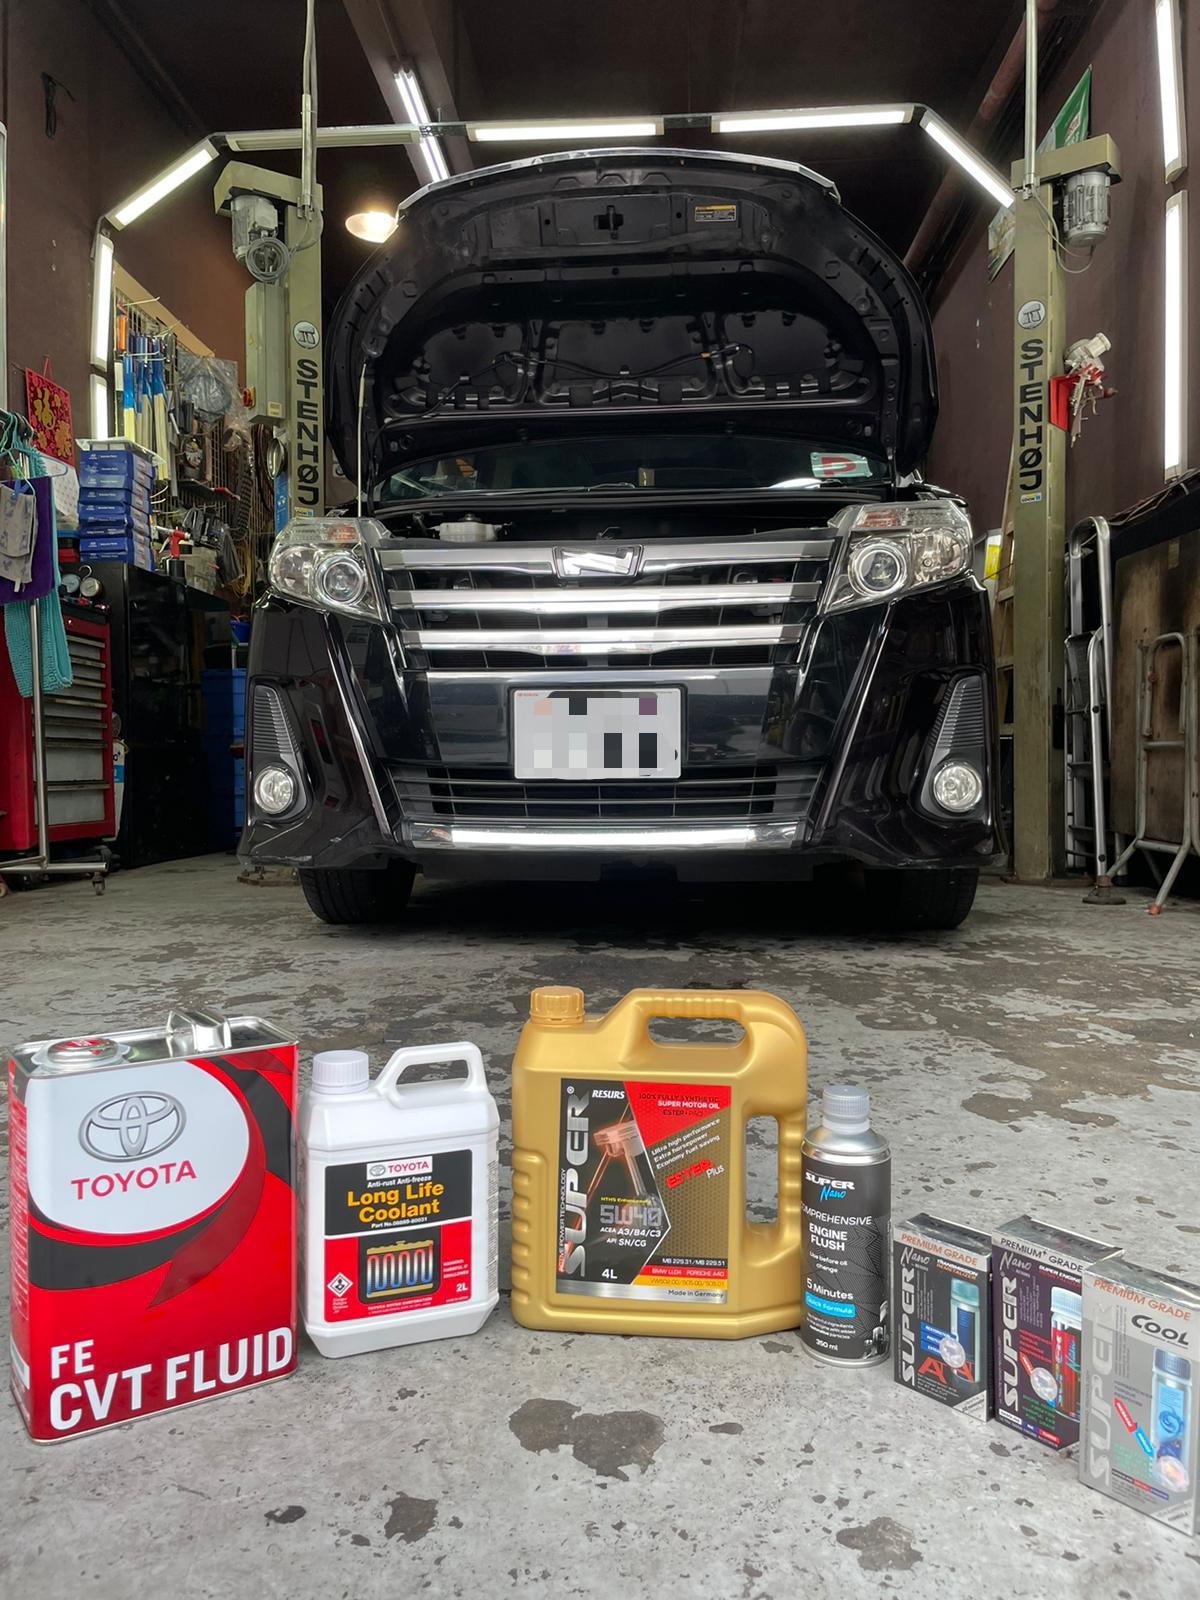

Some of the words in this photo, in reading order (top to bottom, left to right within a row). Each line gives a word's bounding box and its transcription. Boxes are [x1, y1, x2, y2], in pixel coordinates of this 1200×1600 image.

[1019, 338, 1044, 491] STENHØJ
[296, 359, 320, 506] STENHØJ
[592, 1089, 625, 1099] RESURS
[682, 1101, 708, 1109] MOTOR
[651, 1144, 668, 1155] Ultra
[668, 1137, 682, 1148] high
[682, 1118, 720, 1141] performance
[654, 1151, 671, 1163] Extra
[672, 1132, 708, 1154] horsepower
[656, 1152, 685, 1170] Economy
[686, 1145, 698, 1155] fuel
[699, 1135, 720, 1148] saving
[387, 1161, 430, 1173] TOYOTA
[665, 1159, 715, 1189] ESTER
[706, 1164, 724, 1179] Plus
[71, 1160, 197, 1200] TOYOTA
[367, 1179, 396, 1188] Anti-rust
[397, 1175, 432, 1185] Anti-freeze
[564, 1090, 590, 1278] SUPER
[805, 1171, 855, 1190] SUPER
[347, 1189, 399, 1207] Long
[406, 1182, 445, 1200] Life
[820, 1185, 847, 1202] Nano
[358, 1198, 440, 1223] Coolant
[617, 1228, 661, 1237] A3/B4/C3
[809, 1222, 848, 1241] ENGINE
[618, 1239, 647, 1247] SN/CG
[810, 1234, 845, 1251] FLUSH
[901, 1233, 942, 1254] PREMIUM
[943, 1248, 978, 1266] GRADE
[819, 1252, 839, 1264] before
[900, 1246, 930, 1265] Nano
[999, 1251, 1032, 1271] Nano
[1048, 1255, 1084, 1272] GRADE
[601, 1268, 618, 1279] 4L
[456, 1282, 469, 1293] 2L
[694, 1290, 724, 1298] Germany
[806, 1277, 812, 1289] 5
[813, 1283, 854, 1300] Minutes
[1093, 1279, 1146, 1305] PREMIUM
[1148, 1299, 1191, 1321] GRADE
[902, 1267, 915, 1387] SUPER
[1131, 1314, 1189, 1346] COOL
[829, 1343, 838, 1351] ml
[1002, 1276, 1018, 1412] SUPER
[50, 1339, 95, 1380] FE
[50, 1363, 152, 1431] CVT
[166, 1326, 293, 1401] FLUID
